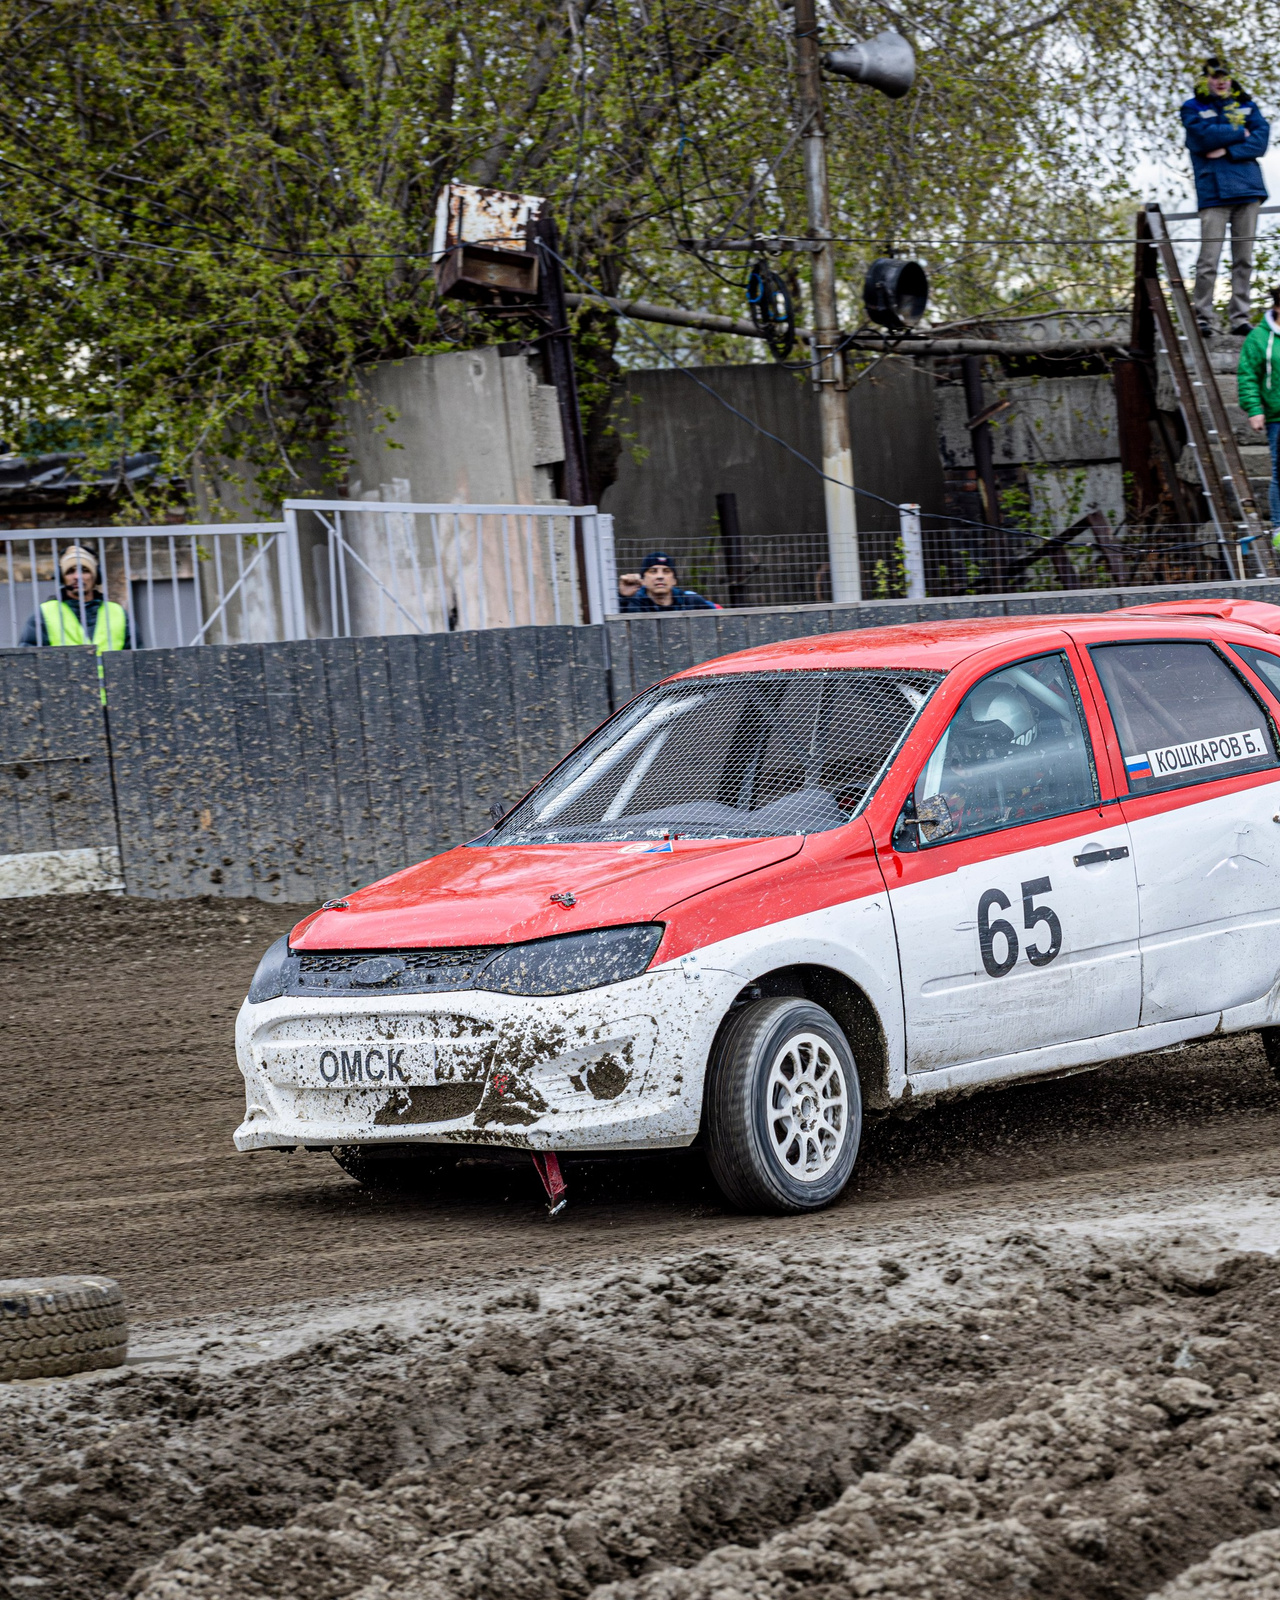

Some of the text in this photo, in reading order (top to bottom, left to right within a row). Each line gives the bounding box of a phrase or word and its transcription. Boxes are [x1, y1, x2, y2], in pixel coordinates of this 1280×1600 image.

[1154, 733, 1261, 773] КОШКАРОВ Б.
[977, 875, 1063, 978] 65
[319, 1050, 405, 1083] ОМСК
